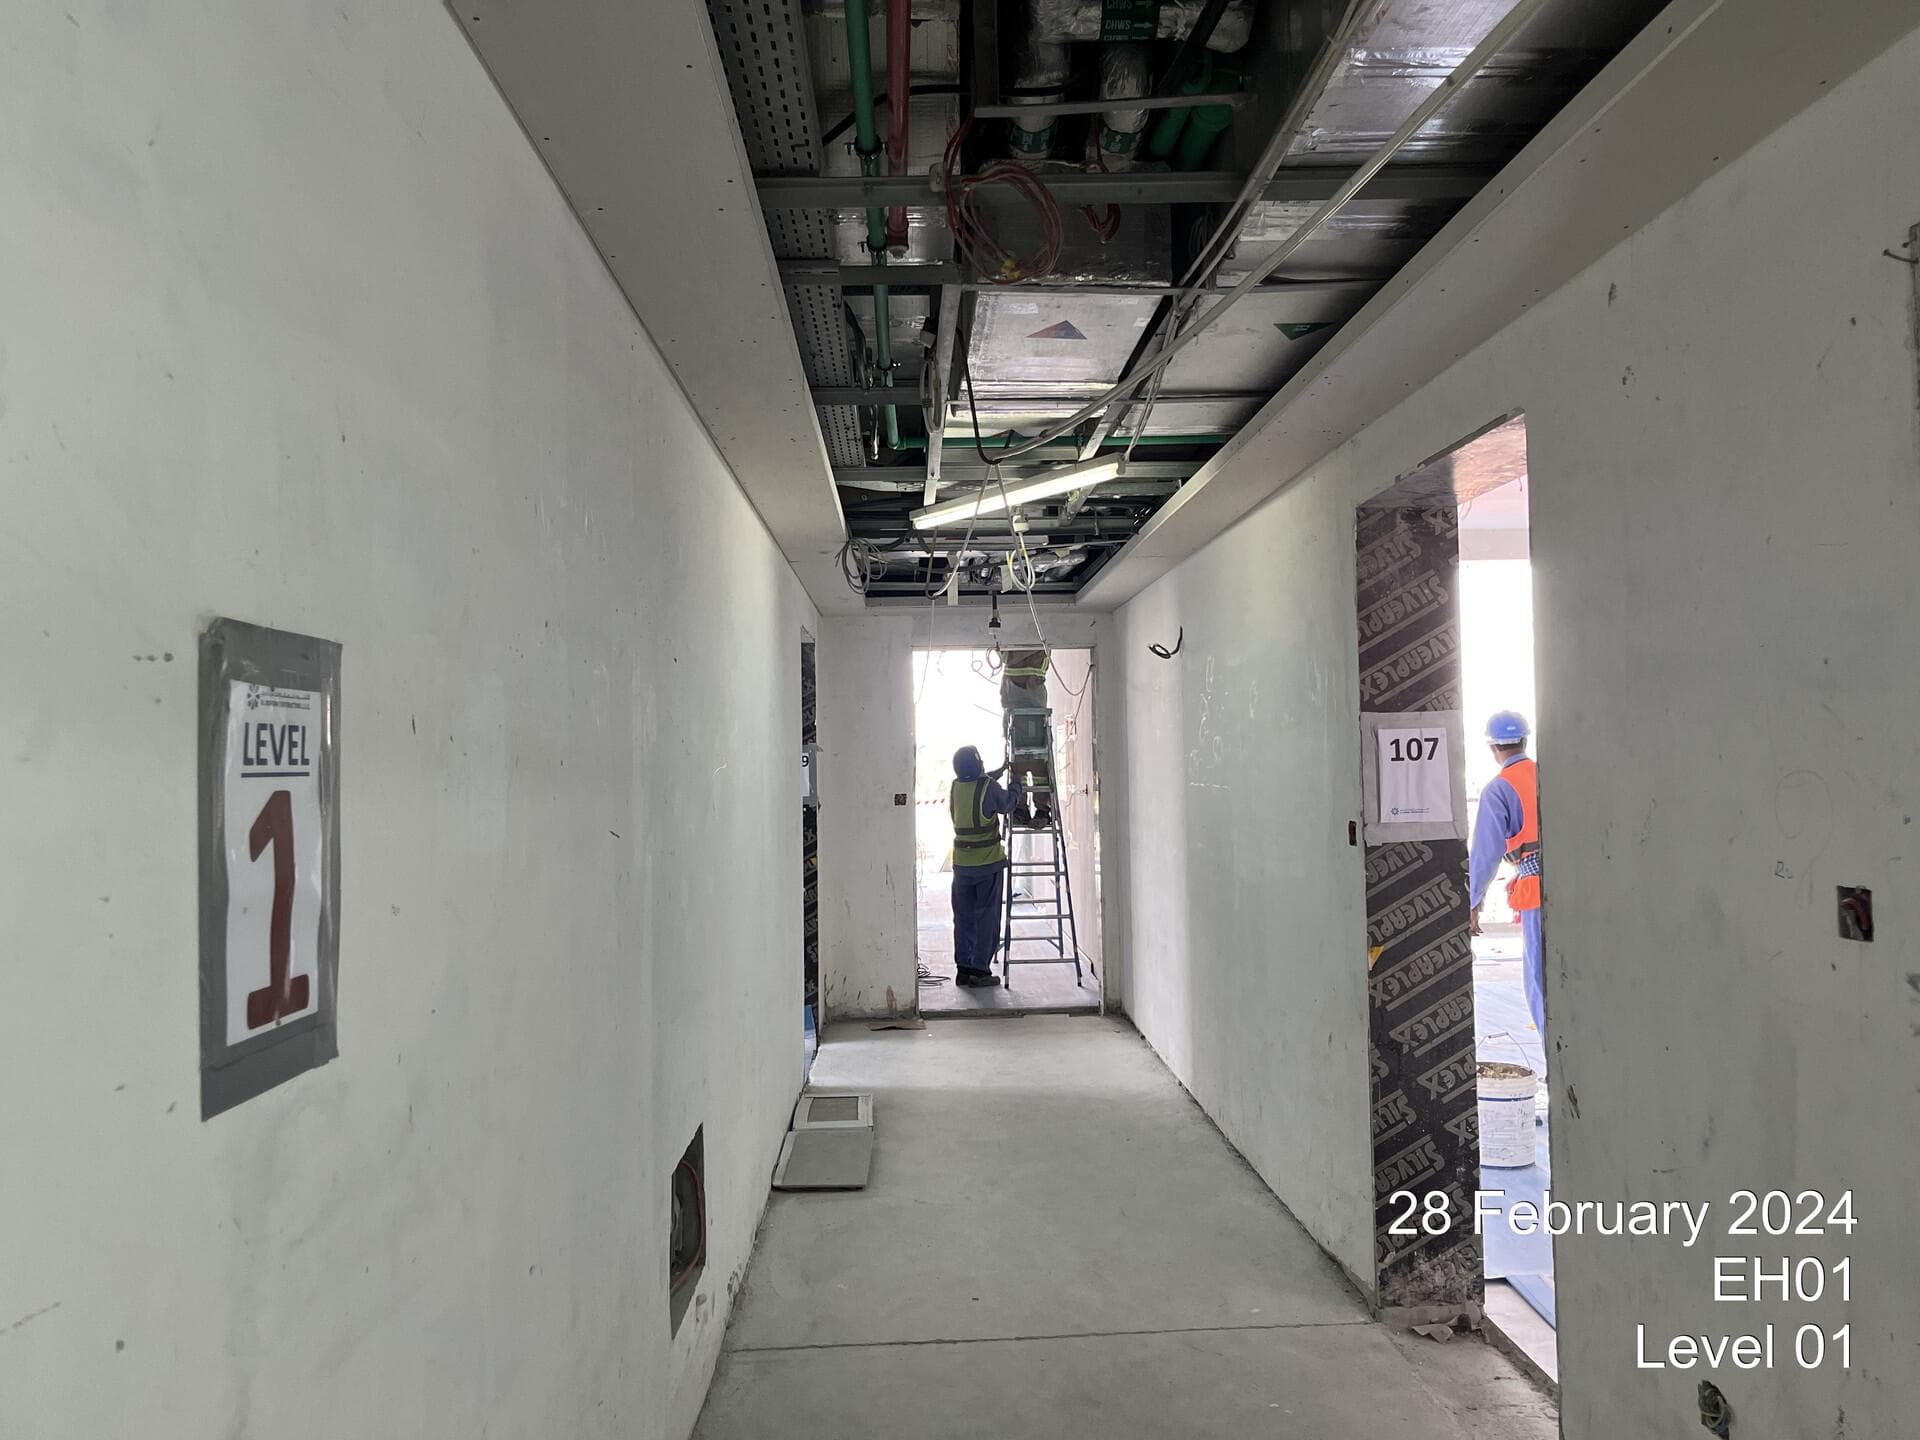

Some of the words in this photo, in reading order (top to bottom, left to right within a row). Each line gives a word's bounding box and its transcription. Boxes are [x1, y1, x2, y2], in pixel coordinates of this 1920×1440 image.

[1105, 19, 1131, 30] CHWS
[243, 721, 310, 766] LEVEL
[1389, 737, 1440, 761] 107
[247, 790, 310, 1030] 1
